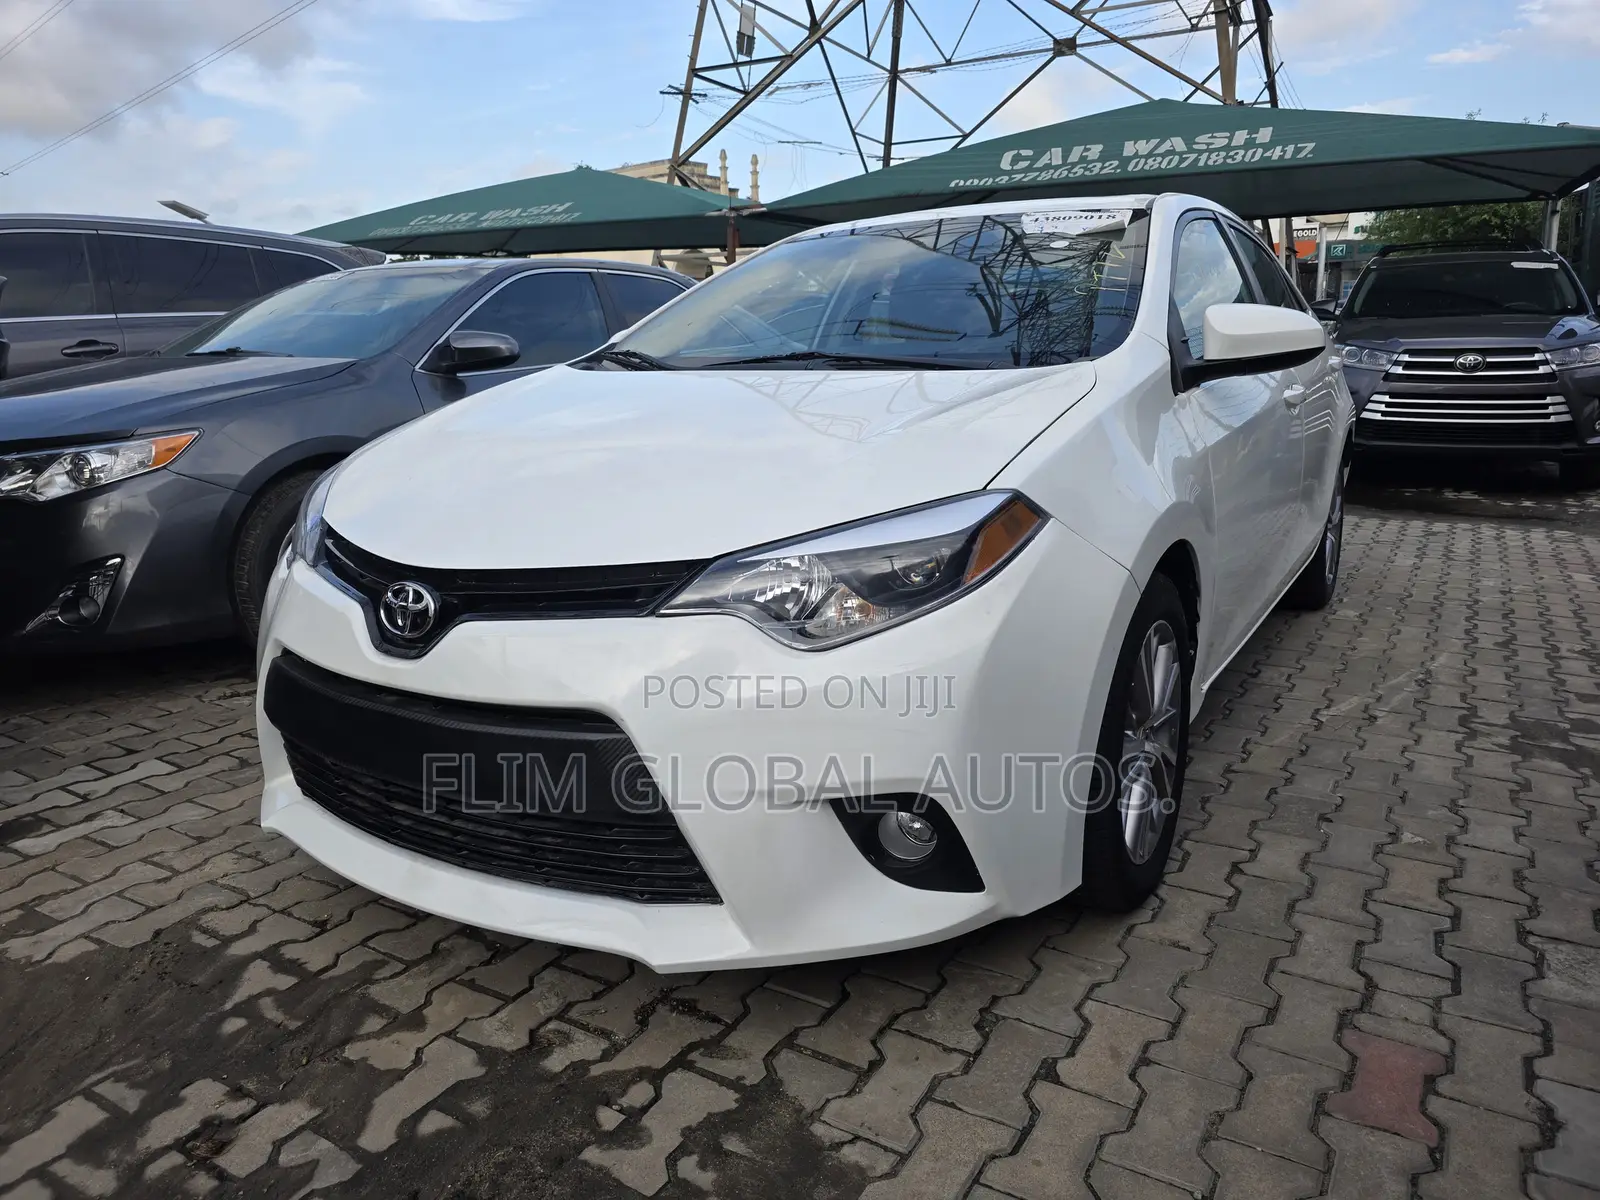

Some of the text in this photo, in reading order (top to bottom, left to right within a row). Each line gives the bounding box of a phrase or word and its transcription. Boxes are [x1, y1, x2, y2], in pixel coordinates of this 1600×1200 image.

[999, 126, 1274, 171] CAR WASH
[408, 211, 478, 226] CAR
[479, 201, 575, 221] WASH
